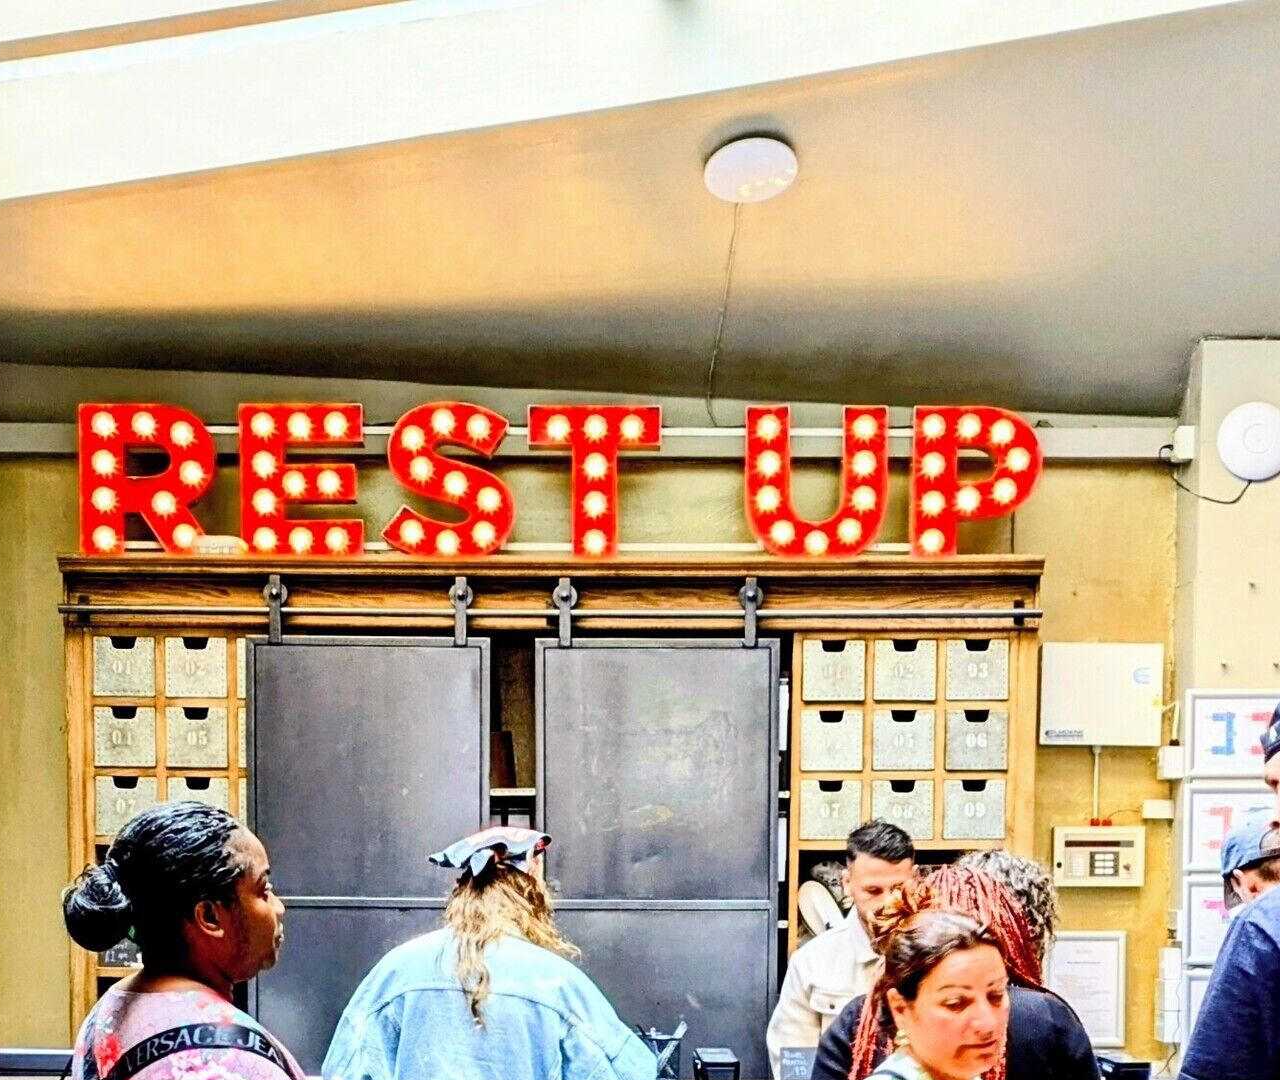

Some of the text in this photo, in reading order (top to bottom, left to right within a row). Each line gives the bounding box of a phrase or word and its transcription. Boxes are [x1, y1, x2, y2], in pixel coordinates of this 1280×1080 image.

[77, 402, 1044, 557] REST UP
[967, 662, 988, 679] 03
[186, 731, 208, 746] 05
[965, 732, 988, 748] 06
[116, 799, 137, 814] 07
[819, 803, 840, 818] 07
[892, 802, 913, 818] 08
[963, 801, 986, 818] 09
[125, 1025, 285, 1073] VERSACE JEA
